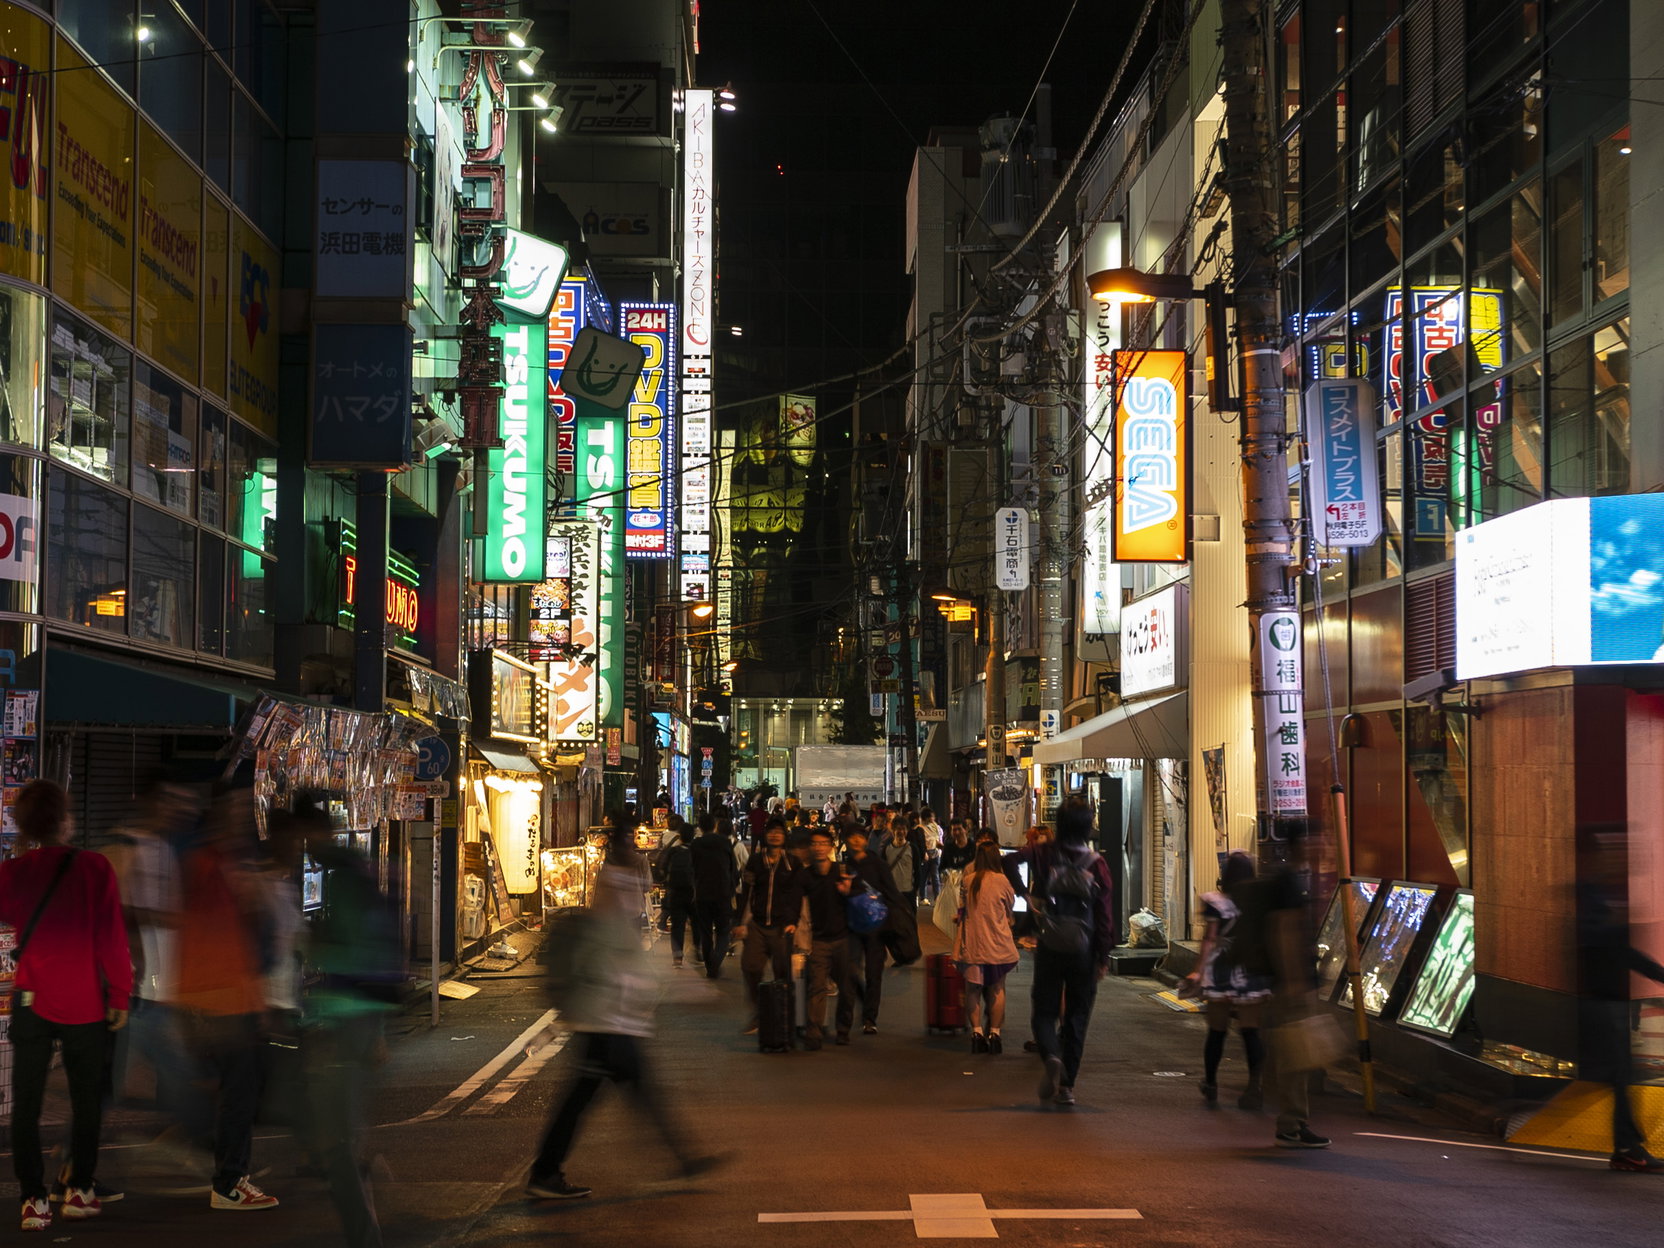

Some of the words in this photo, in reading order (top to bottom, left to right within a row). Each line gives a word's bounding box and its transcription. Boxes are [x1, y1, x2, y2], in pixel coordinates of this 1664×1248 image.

[58, 121, 129, 222] Transcend
[321, 197, 403, 216] センサーの
[141, 196, 197, 278] Transcend
[319, 231, 406, 256] 浜田電機
[627, 312, 667, 330] 24H
[317, 361, 397, 379] オートメの
[317, 390, 403, 423] ハマダ
[501, 325, 529, 579] TSUKUMO
[1123, 377, 1178, 535] SEGA
[1328, 387, 1359, 501] コスメイトプラス
[539, 608, 561, 619] 2F
[416, 747, 433, 775] P
[427, 762, 440, 775] 60
